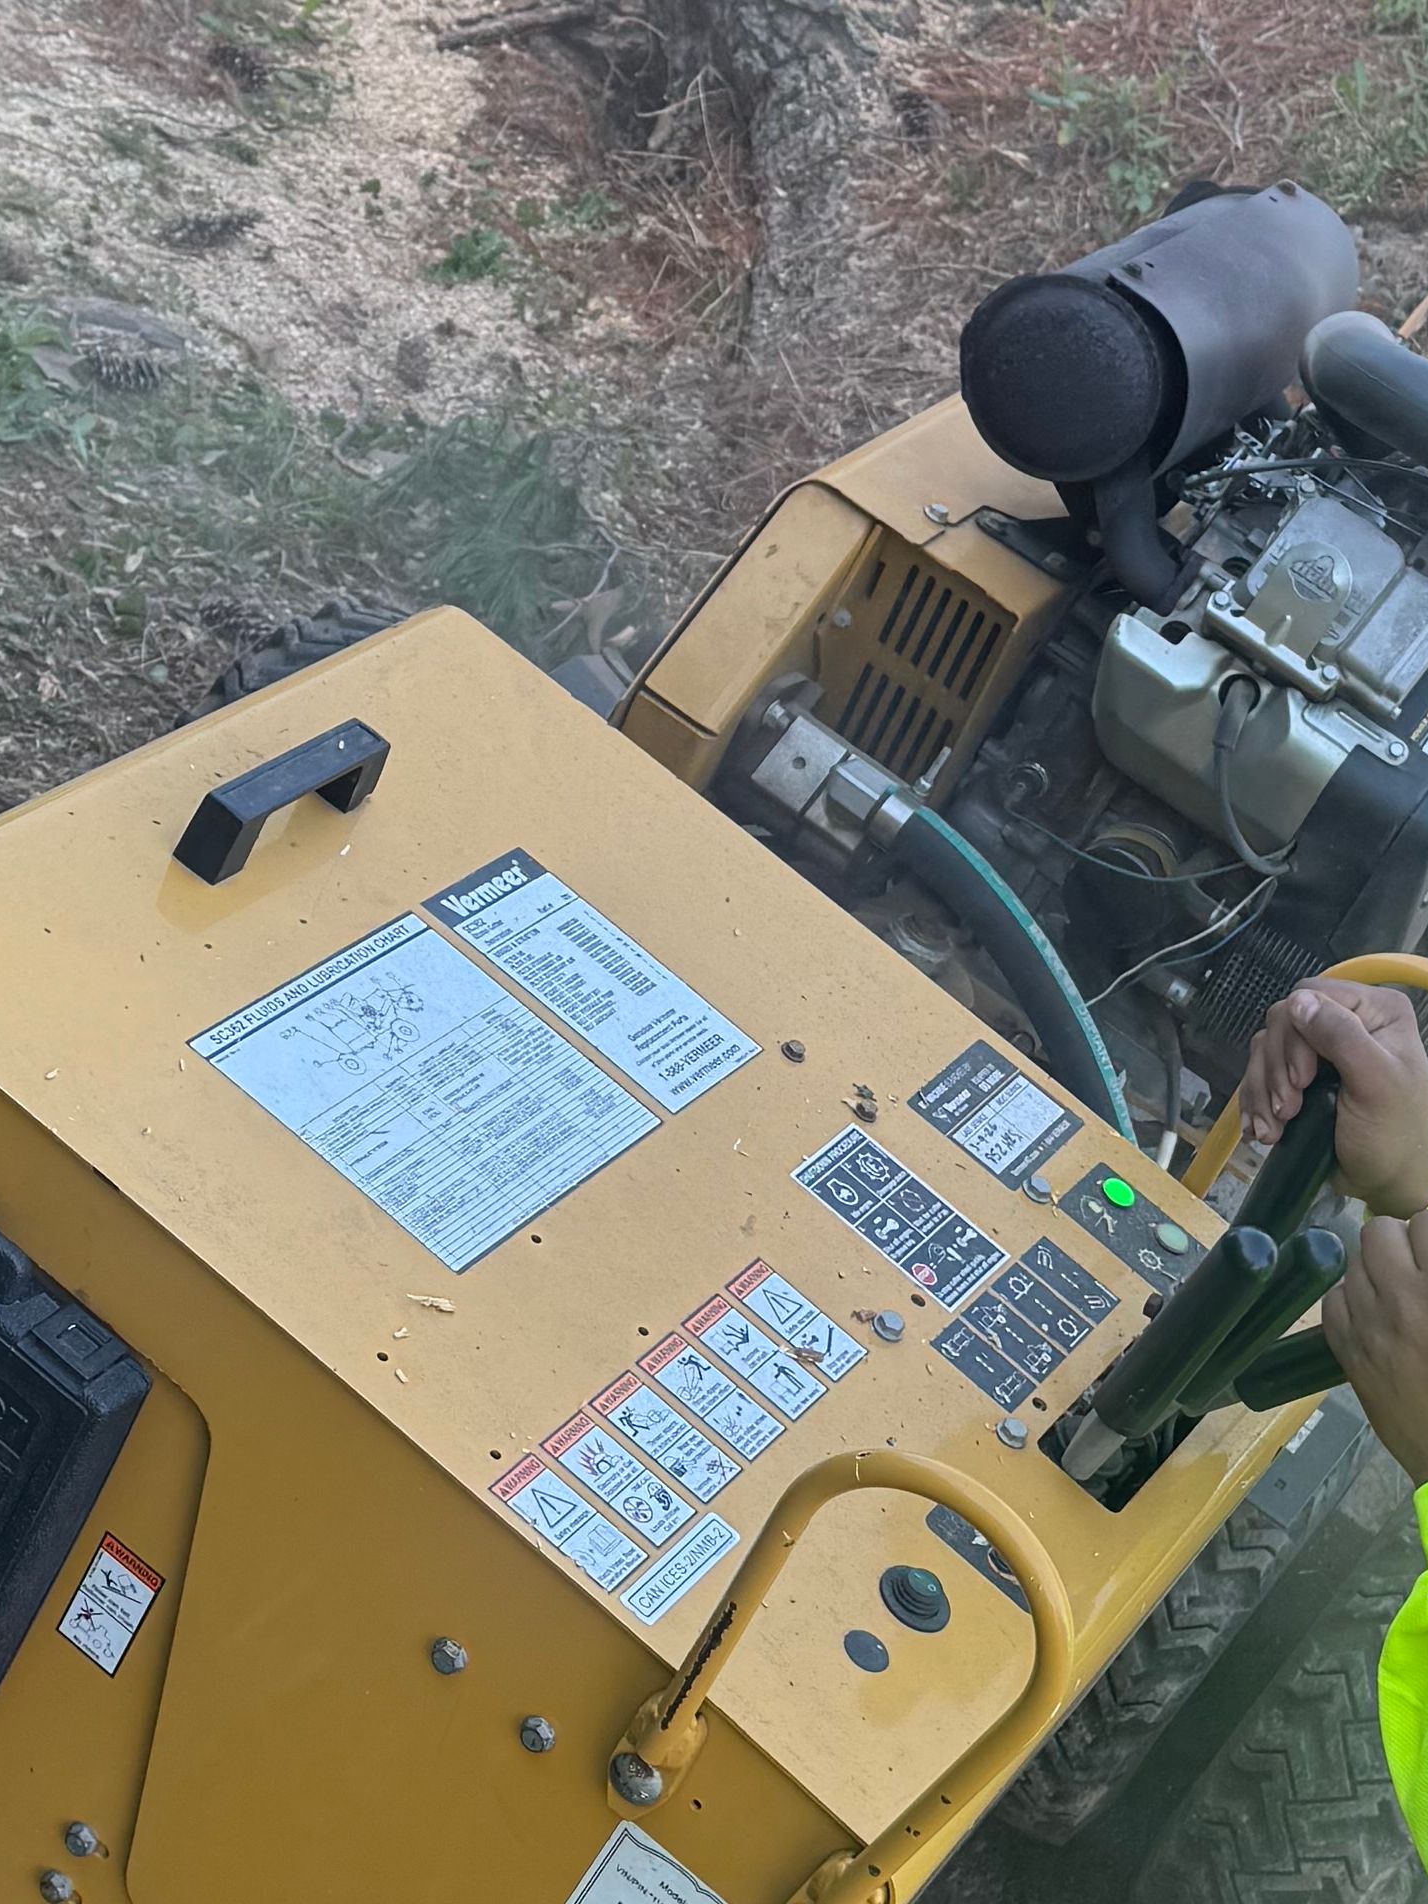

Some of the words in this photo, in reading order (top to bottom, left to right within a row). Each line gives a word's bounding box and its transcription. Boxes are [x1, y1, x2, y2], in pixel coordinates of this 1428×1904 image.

[438, 860, 533, 919] Vermeer
[242, 996, 286, 1025] FLUIDS
[280, 982, 310, 1002] AND
[304, 942, 377, 988] LUBRICATION
[371, 922, 411, 949] CHART
[667, 1044, 744, 1096] www.vermeer.com
[797, 1155, 833, 1184] SHUTDOWN
[825, 1129, 863, 1161] PROCEDURE
[736, 1263, 770, 1292] WARNING
[691, 1298, 728, 1328] WARNING
[646, 1336, 685, 1367] WARNING
[601, 1375, 640, 1407] WARNING
[552, 1416, 593, 1449] WARNING
[499, 1458, 542, 1492] WARNING
[113, 1545, 158, 1587] WARNING
[636, 1583, 665, 1610] CAN
[657, 1525, 726, 1589] ICES-2/NMB-2
